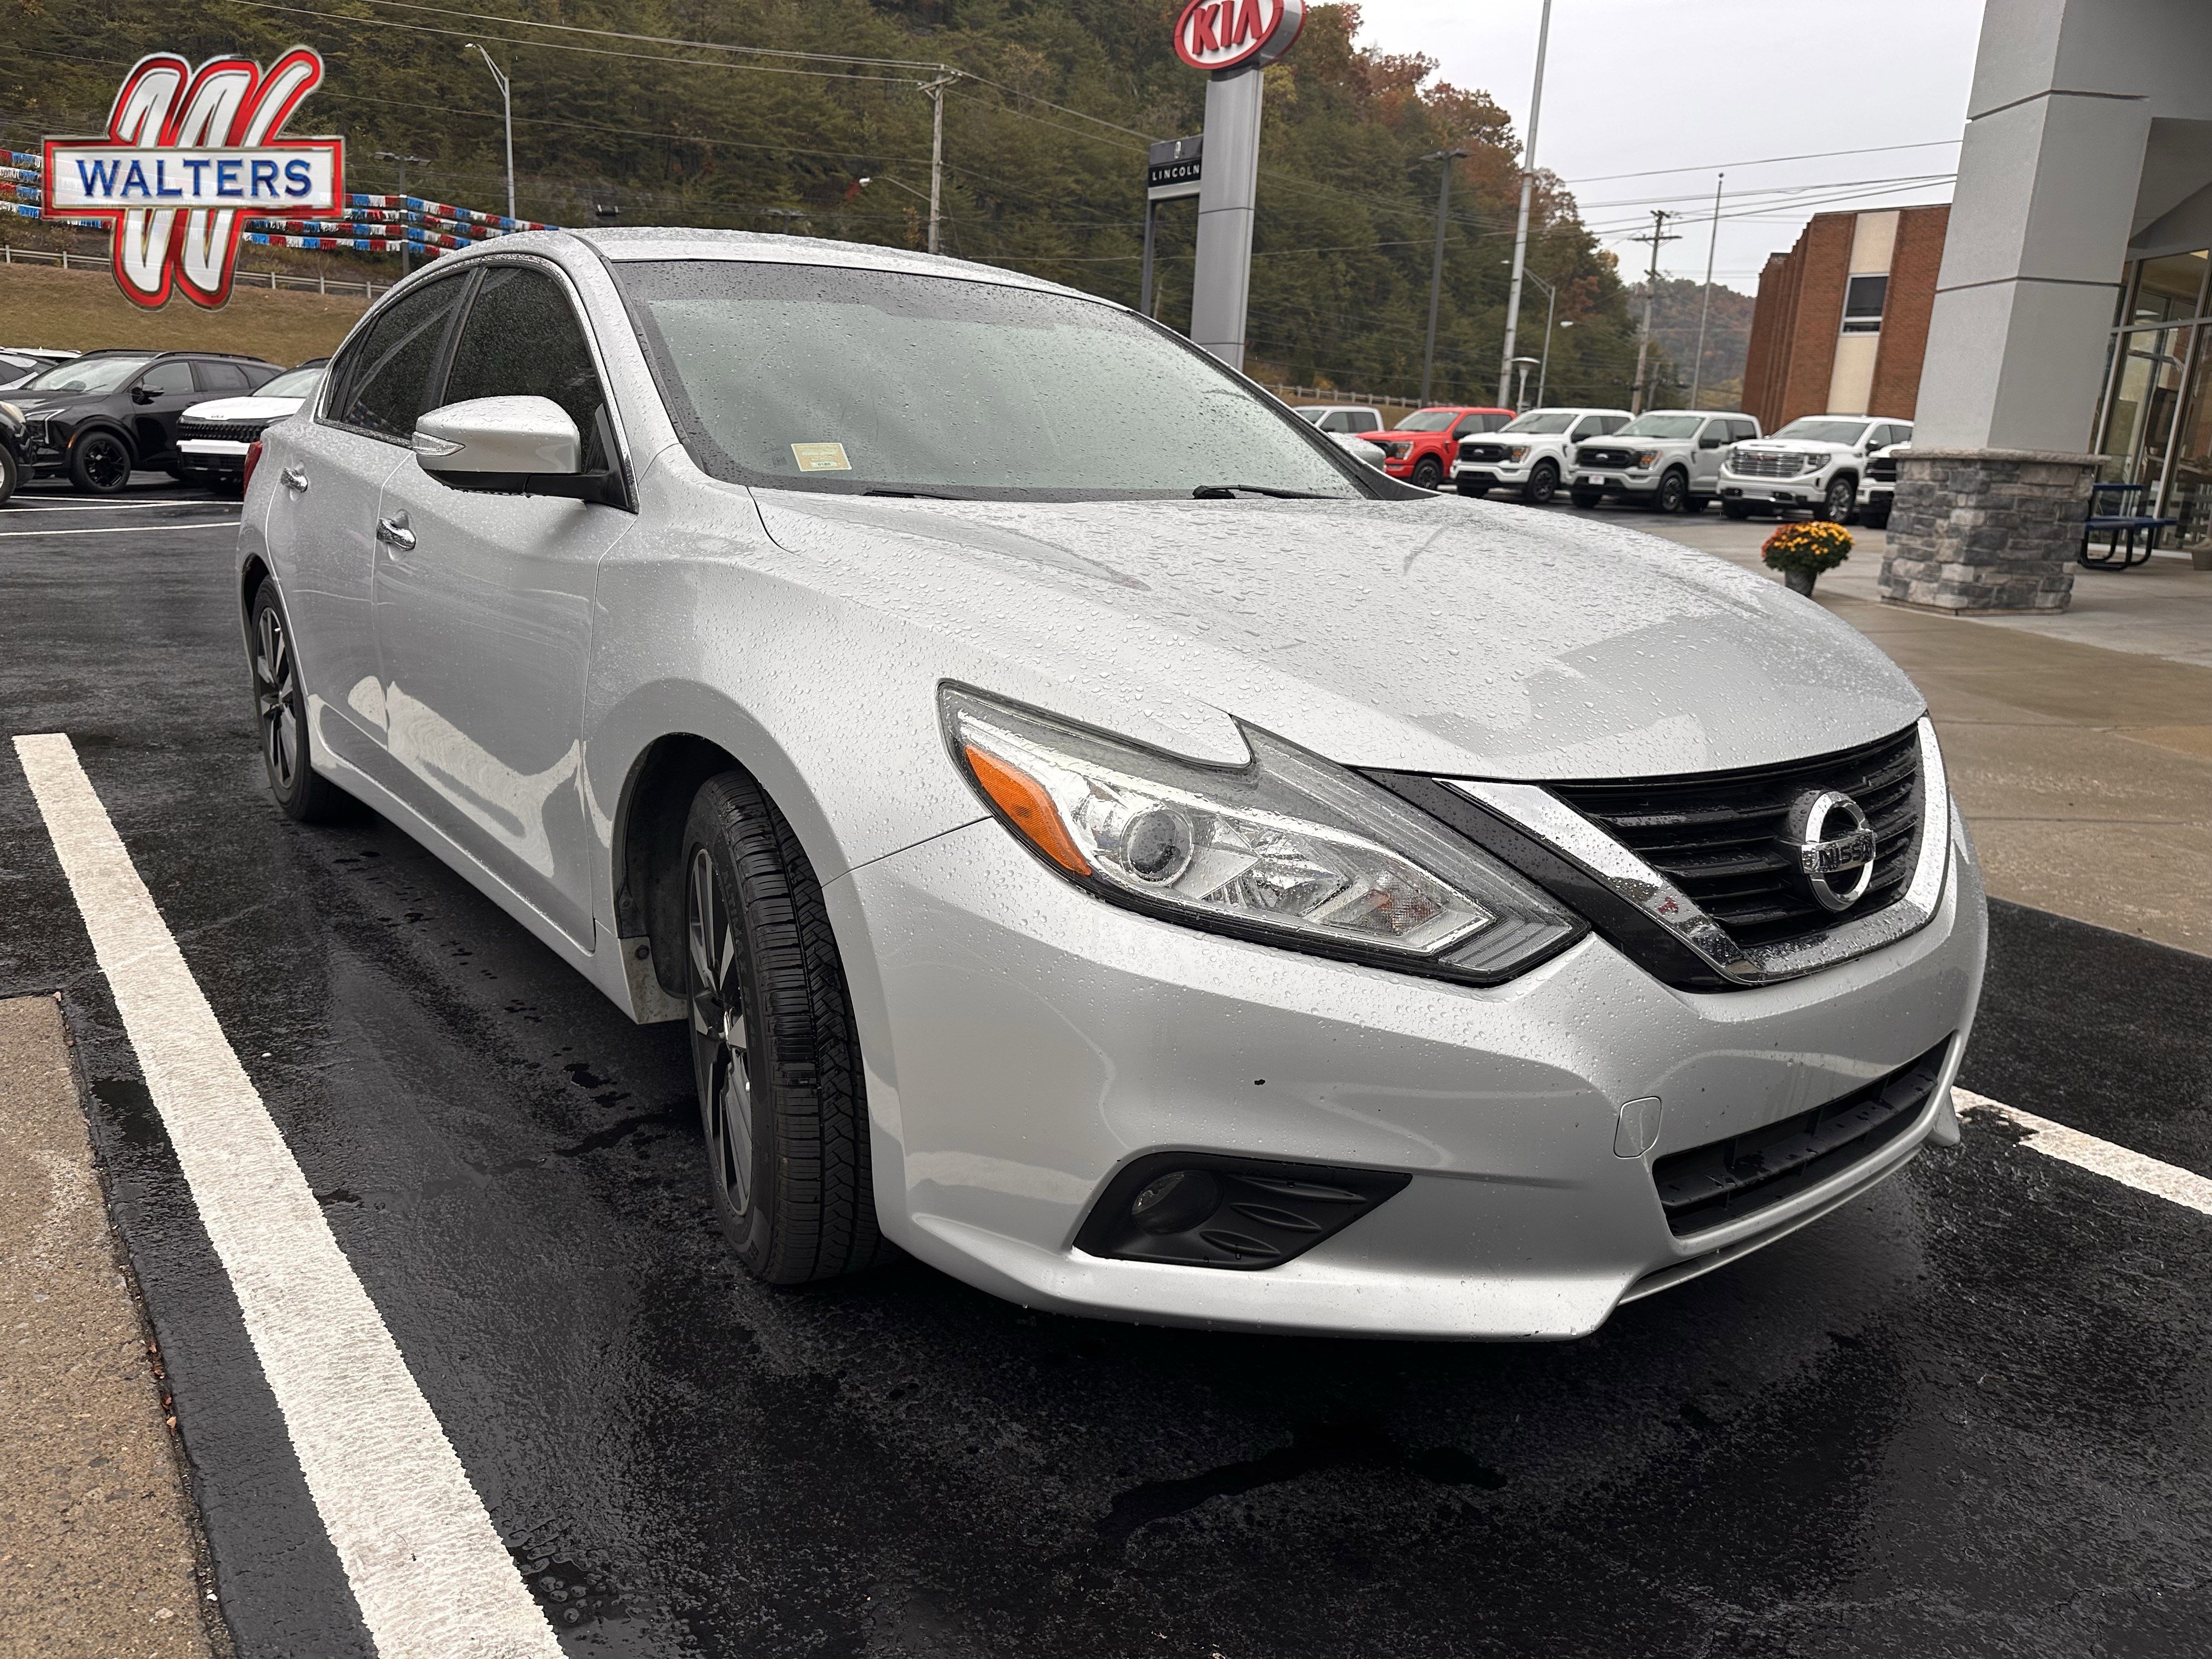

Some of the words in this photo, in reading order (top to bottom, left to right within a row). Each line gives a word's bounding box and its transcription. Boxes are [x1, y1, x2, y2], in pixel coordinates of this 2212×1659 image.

[1192, 0, 1263, 55] KIA
[1152, 164, 1200, 181] LINCOLN
[1819, 833, 1872, 867] NISS
